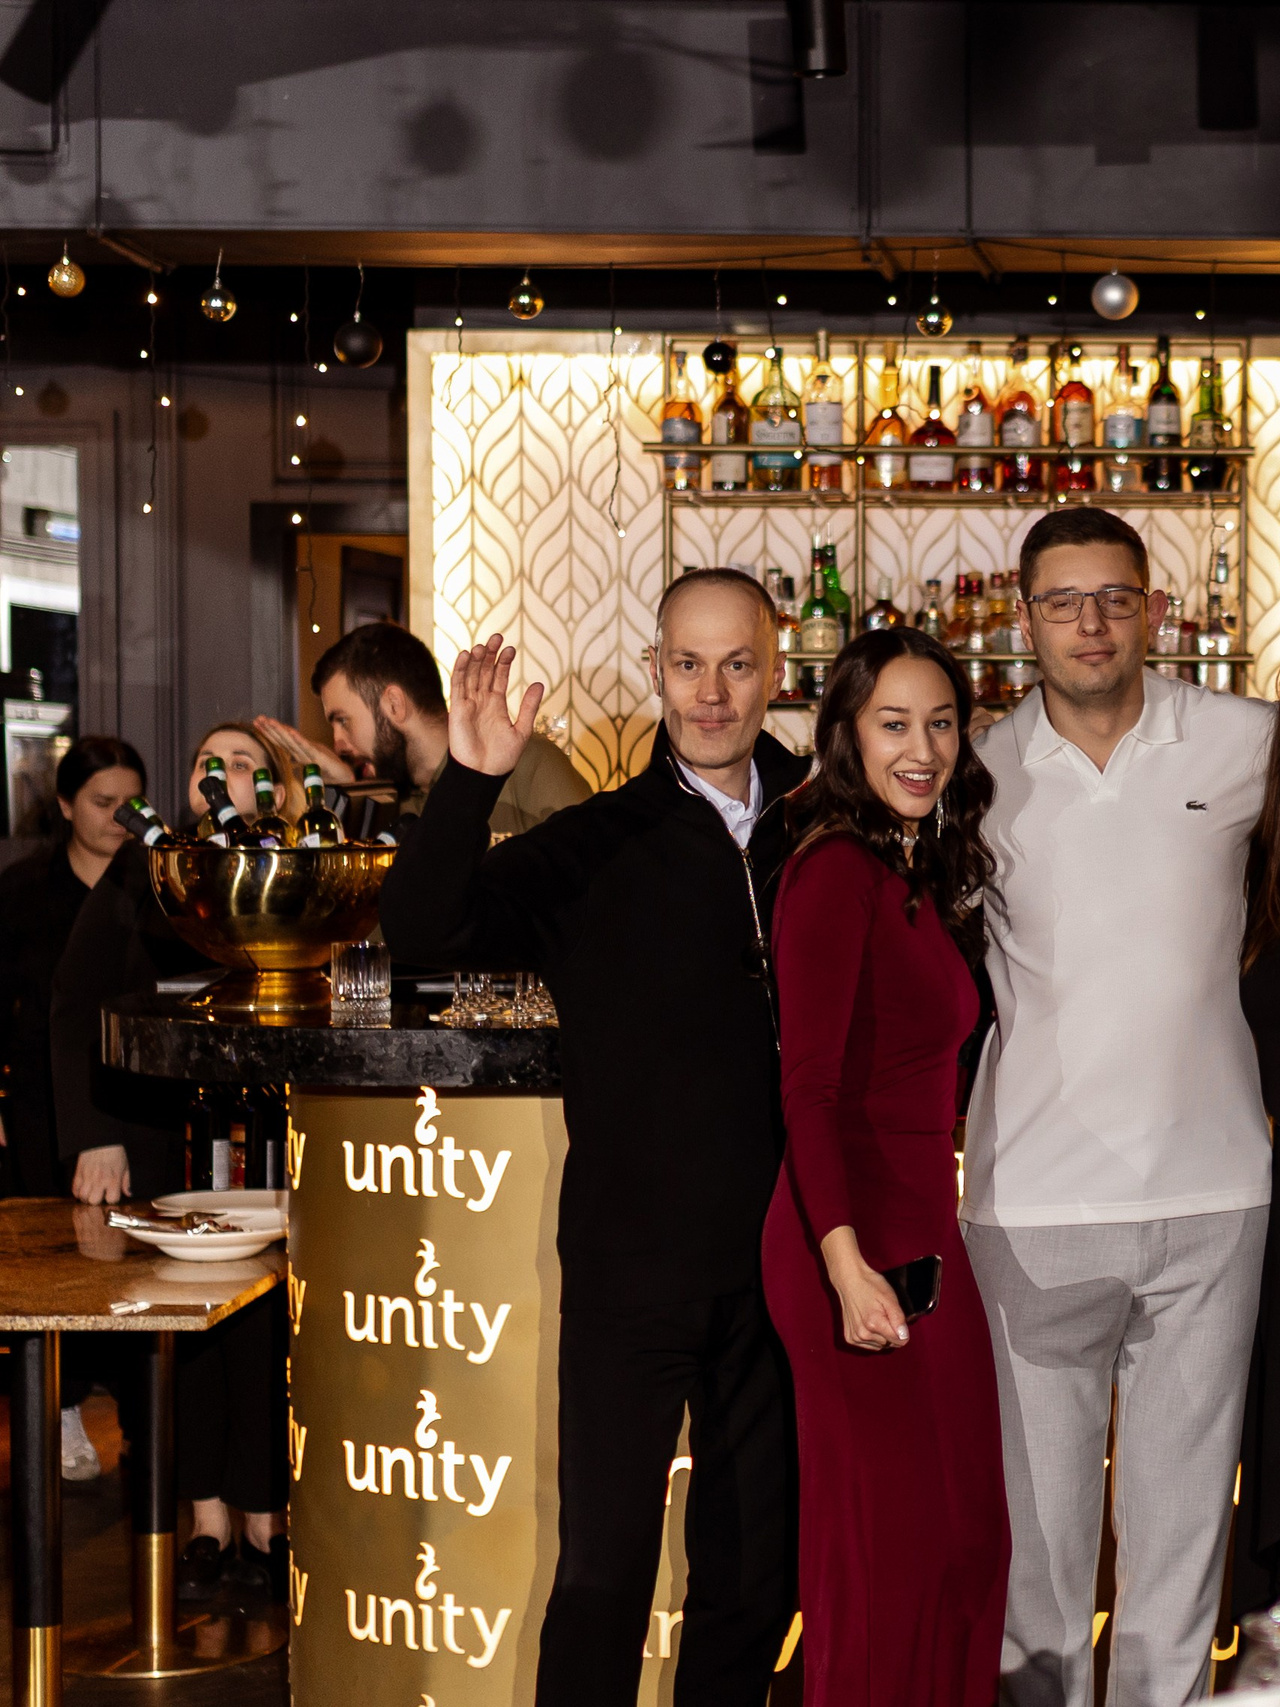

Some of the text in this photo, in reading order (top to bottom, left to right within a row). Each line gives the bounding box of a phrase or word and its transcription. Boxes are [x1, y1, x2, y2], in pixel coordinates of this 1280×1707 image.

[343, 1087, 512, 1212] unity
[343, 1239, 512, 1364] unity
[343, 1390, 512, 1517] unity
[345, 1542, 512, 1668] unity
